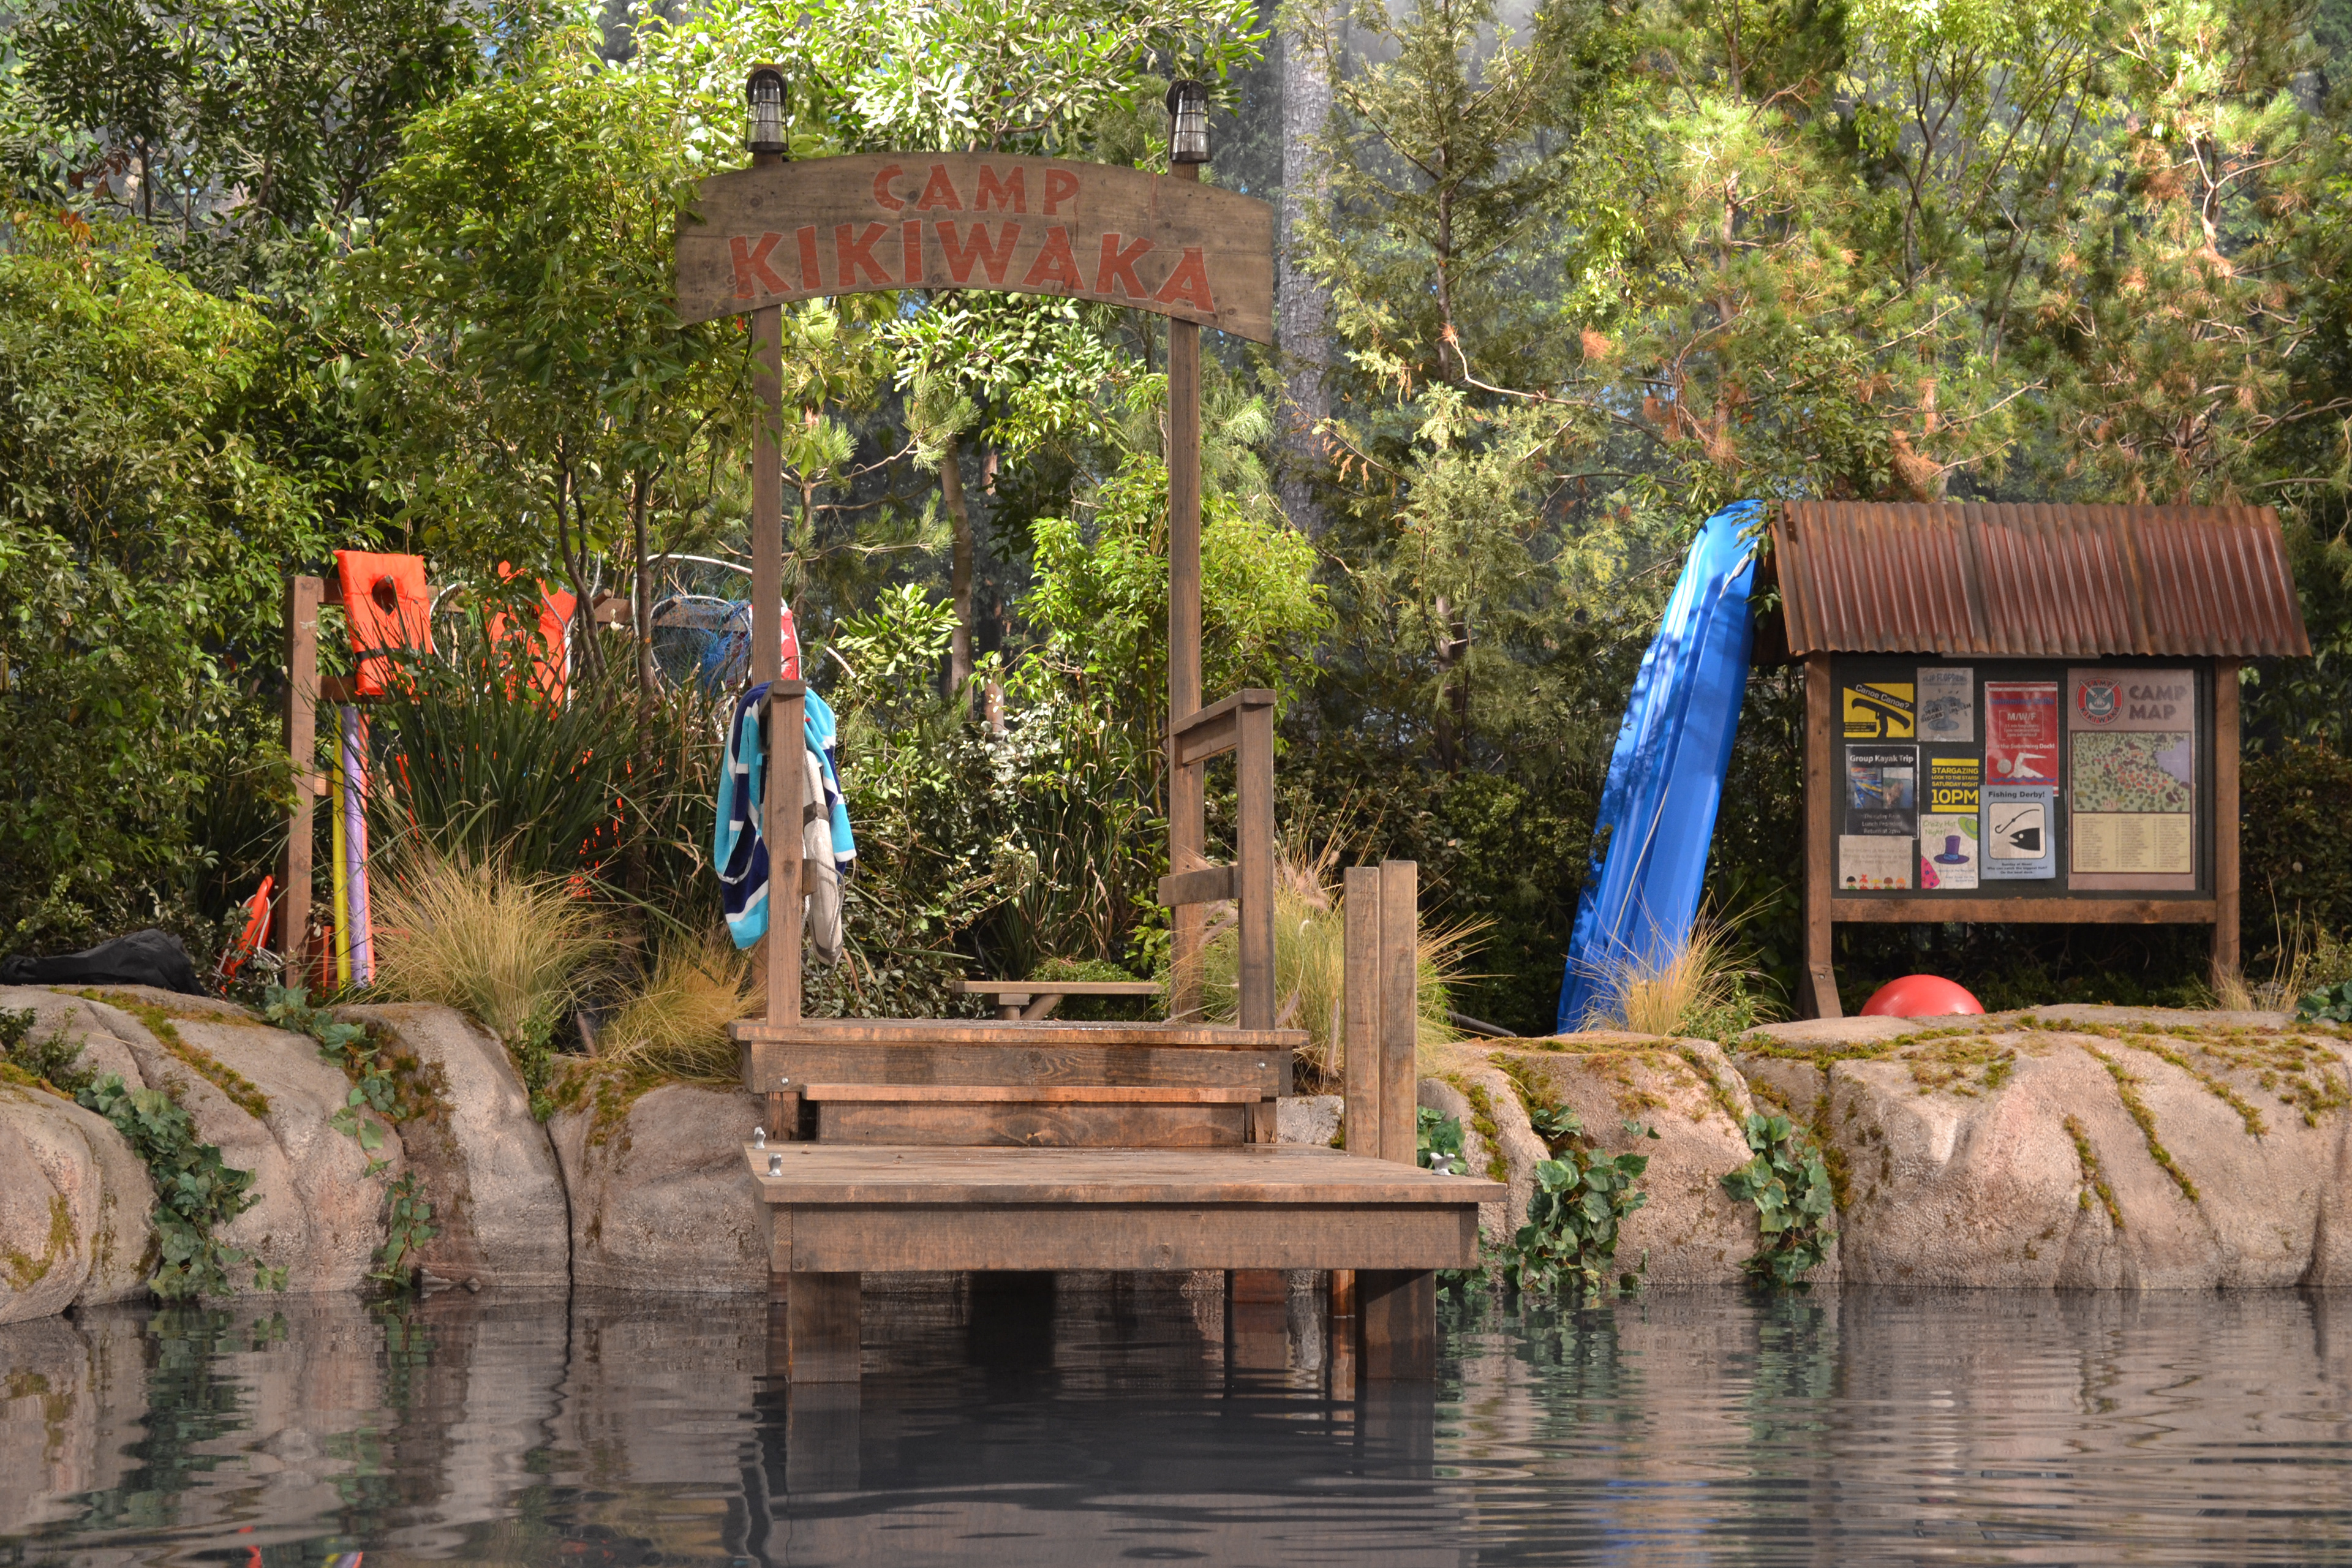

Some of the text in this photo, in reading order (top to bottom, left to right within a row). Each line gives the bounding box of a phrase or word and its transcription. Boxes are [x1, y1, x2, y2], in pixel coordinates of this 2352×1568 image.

[872, 163, 1080, 216] CAMP
[728, 219, 1216, 314] KIKIWAKA
[2087, 679, 2113, 688] CAMP
[1855, 684, 1910, 709] Canoe Canoe?
[2129, 685, 2188, 701] CAMP
[2007, 712, 2037, 721] M/W/F
[2079, 707, 2120, 723] KIKIWAKA
[2129, 704, 2177, 720] MAP
[1849, 755, 1914, 764] Group Kayak Trip
[1931, 789, 1979, 804] 10PM
